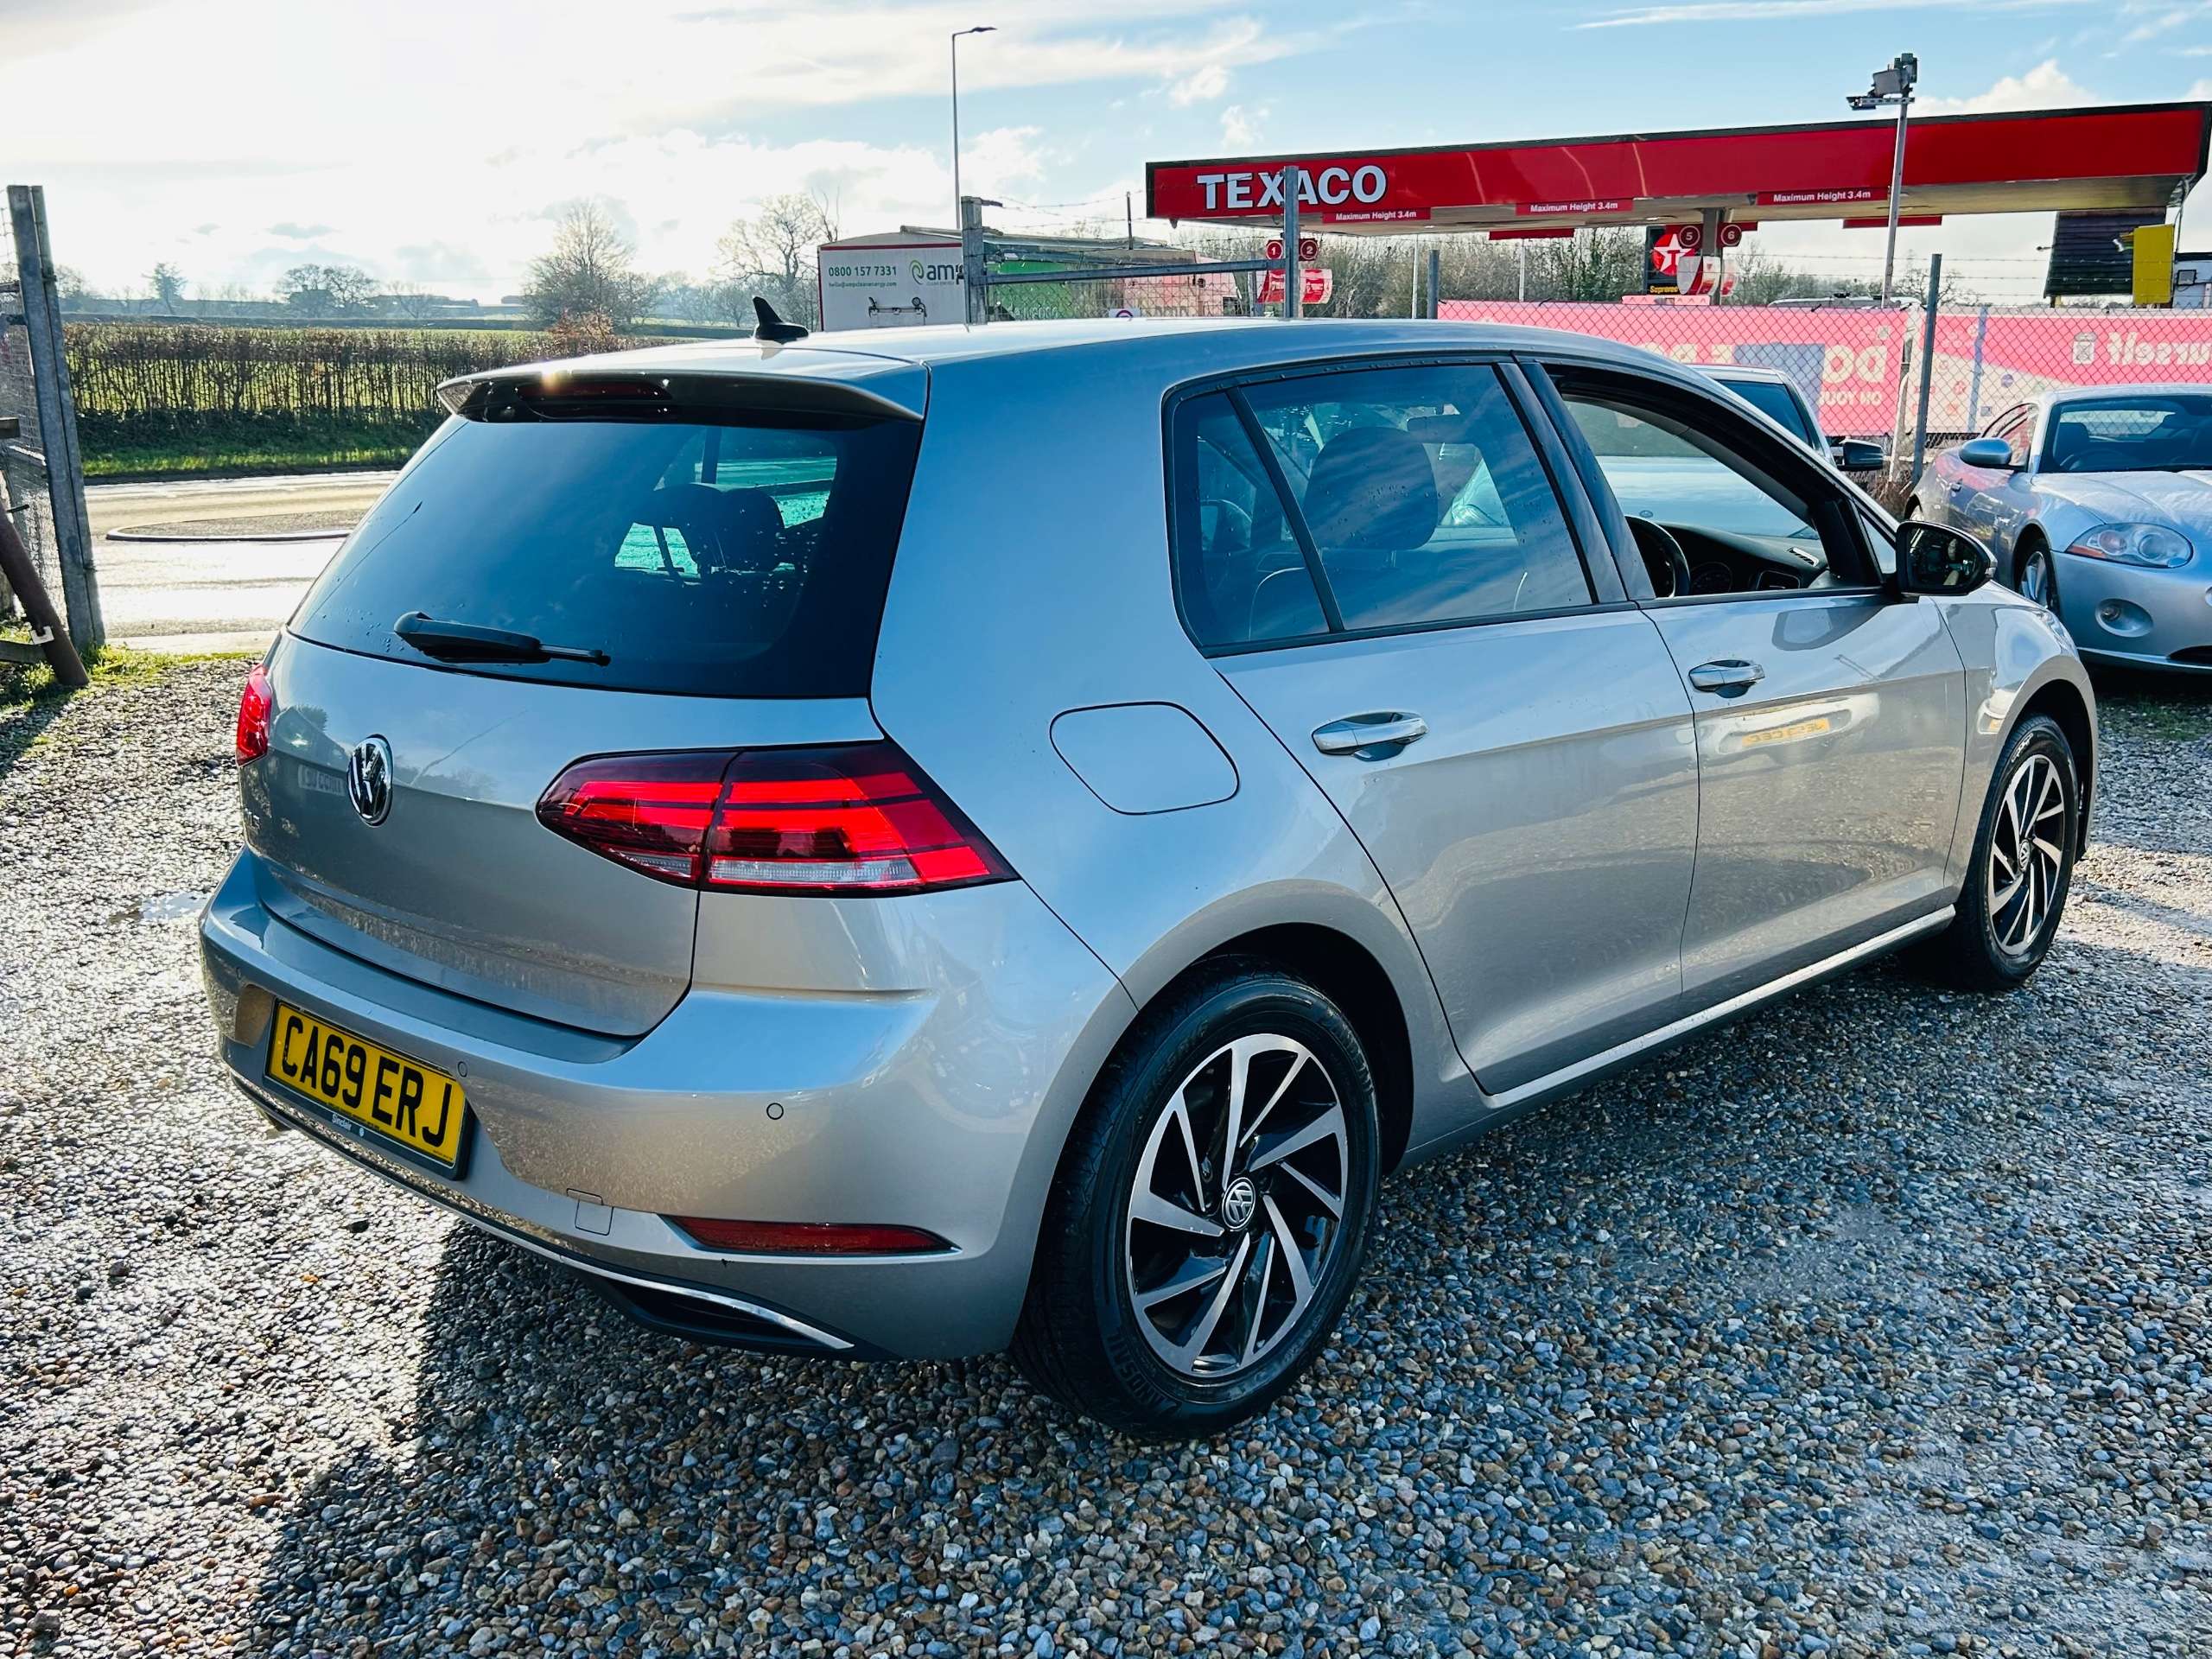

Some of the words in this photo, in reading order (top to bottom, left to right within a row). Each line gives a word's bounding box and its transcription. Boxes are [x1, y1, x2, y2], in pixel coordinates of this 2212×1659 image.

[1197, 165, 1387, 209] TEXACO
[1773, 193, 1815, 202] Maximum
[1816, 191, 1847, 201] Height
[1847, 190, 1871, 200] 3.4m
[1530, 204, 1568, 213] Maximum
[1569, 202, 1597, 212] Height
[1598, 201, 1618, 210] 3.4m
[1336, 213, 1370, 221] Maximum
[1371, 211, 1396, 219] Height
[1397, 210, 1417, 219] 3.4m
[1685, 232, 1694, 240] 5
[1727, 231, 1735, 239] 6
[1306, 245, 1314, 255] 2
[829, 266, 852, 276] 0800
[854, 265, 871, 276] 157
[874, 265, 897, 276] 7331
[282, 1015, 367, 1109] CA69
[371, 1055, 453, 1148] ERJ
